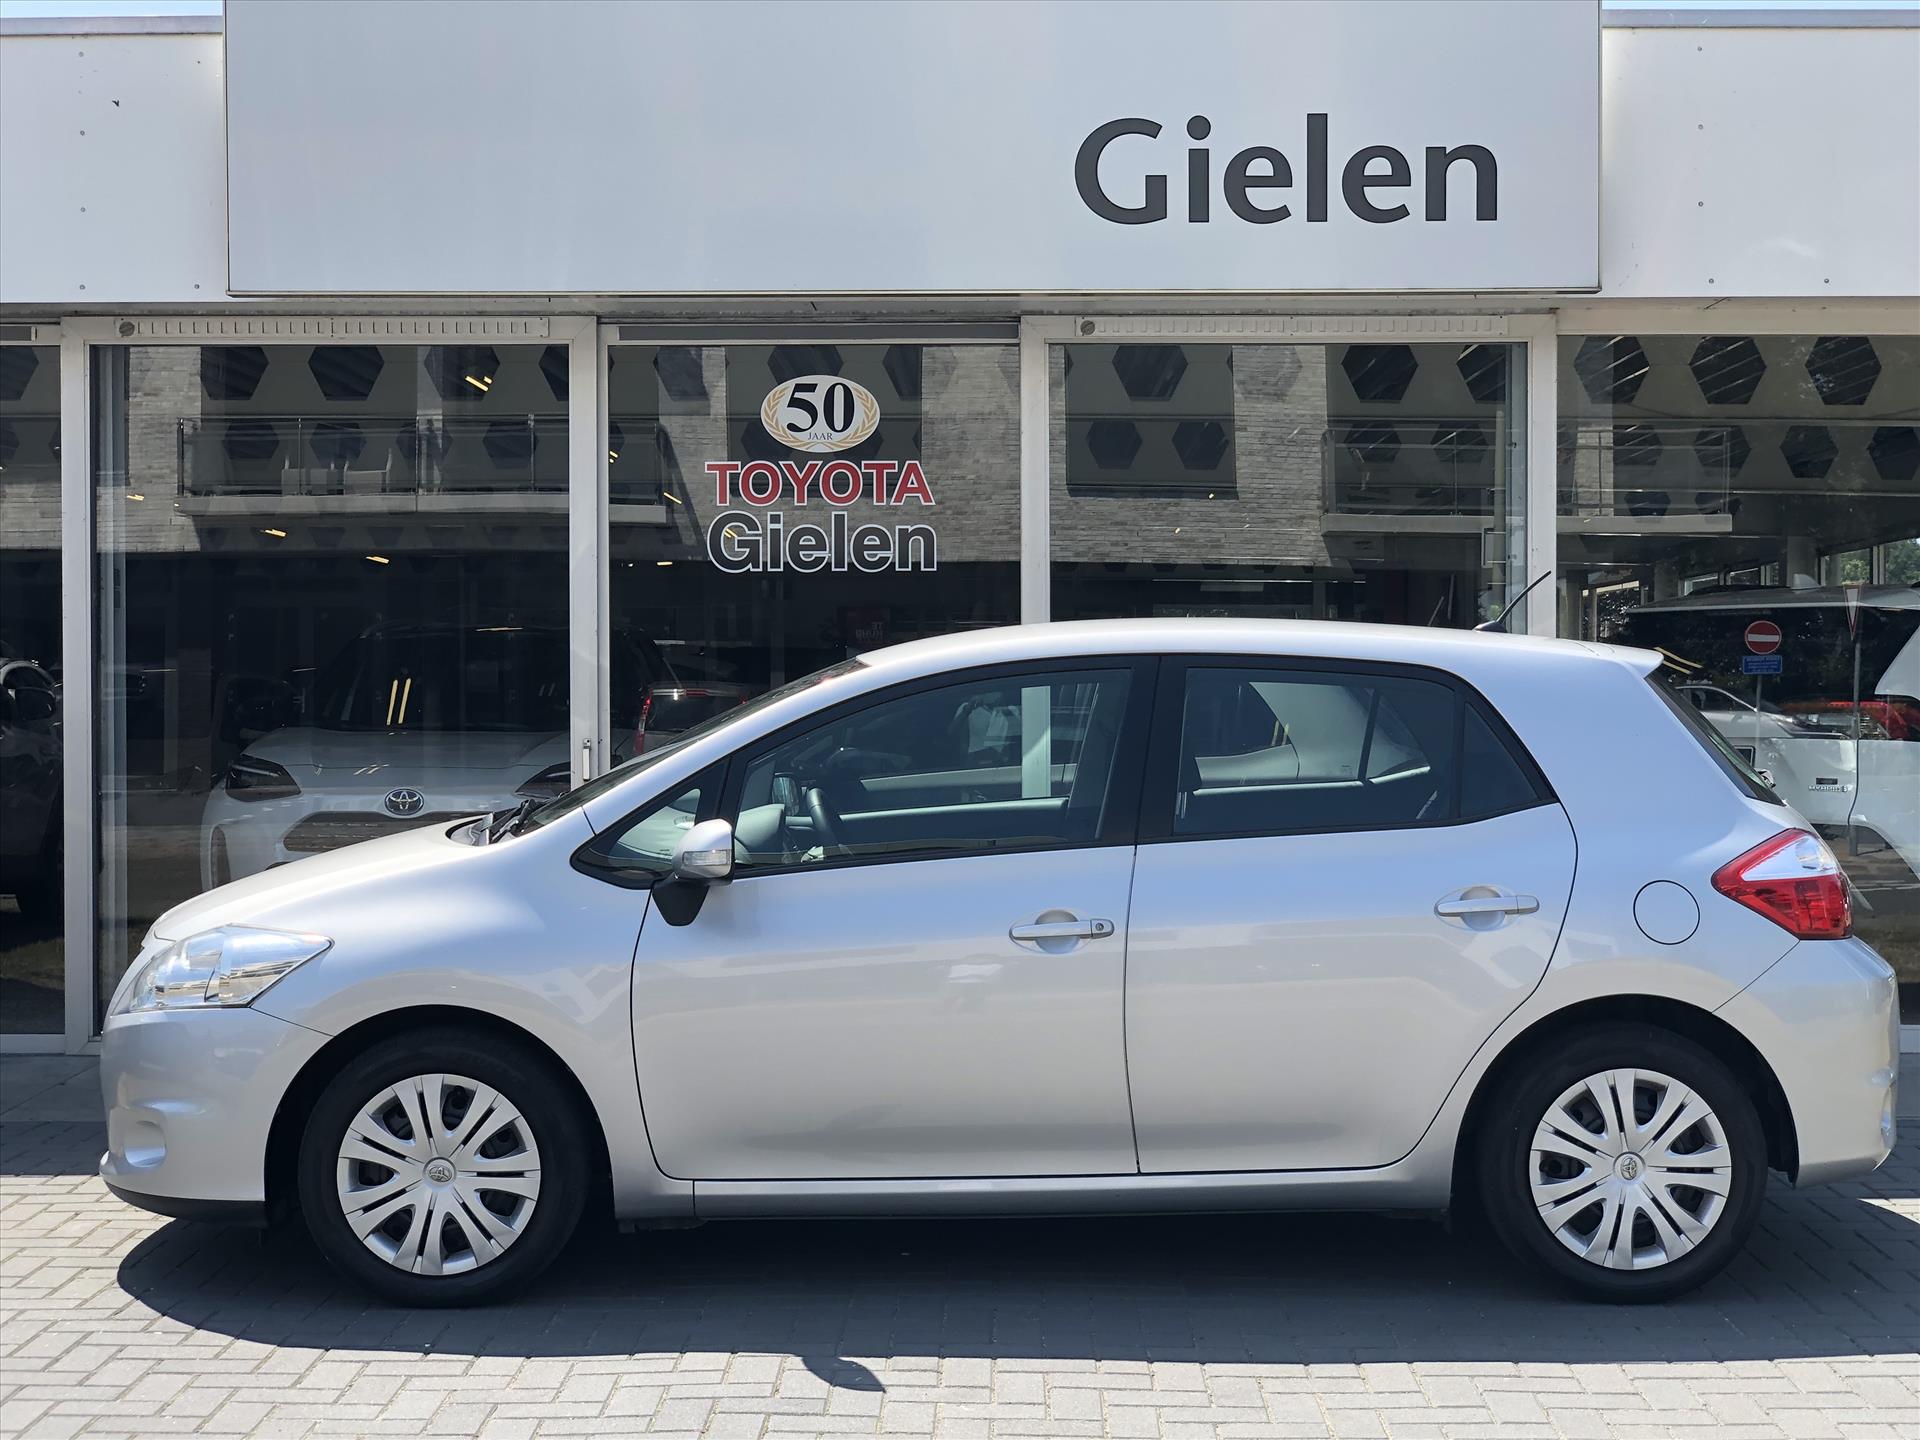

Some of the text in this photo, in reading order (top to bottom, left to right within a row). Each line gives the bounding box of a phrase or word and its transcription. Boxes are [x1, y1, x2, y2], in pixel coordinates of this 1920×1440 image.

[1074, 112, 1498, 225] Gielen
[786, 382, 855, 433] 50
[808, 432, 833, 441] JAAR
[704, 460, 936, 507] TOYOTA
[706, 510, 938, 574] Gielen
